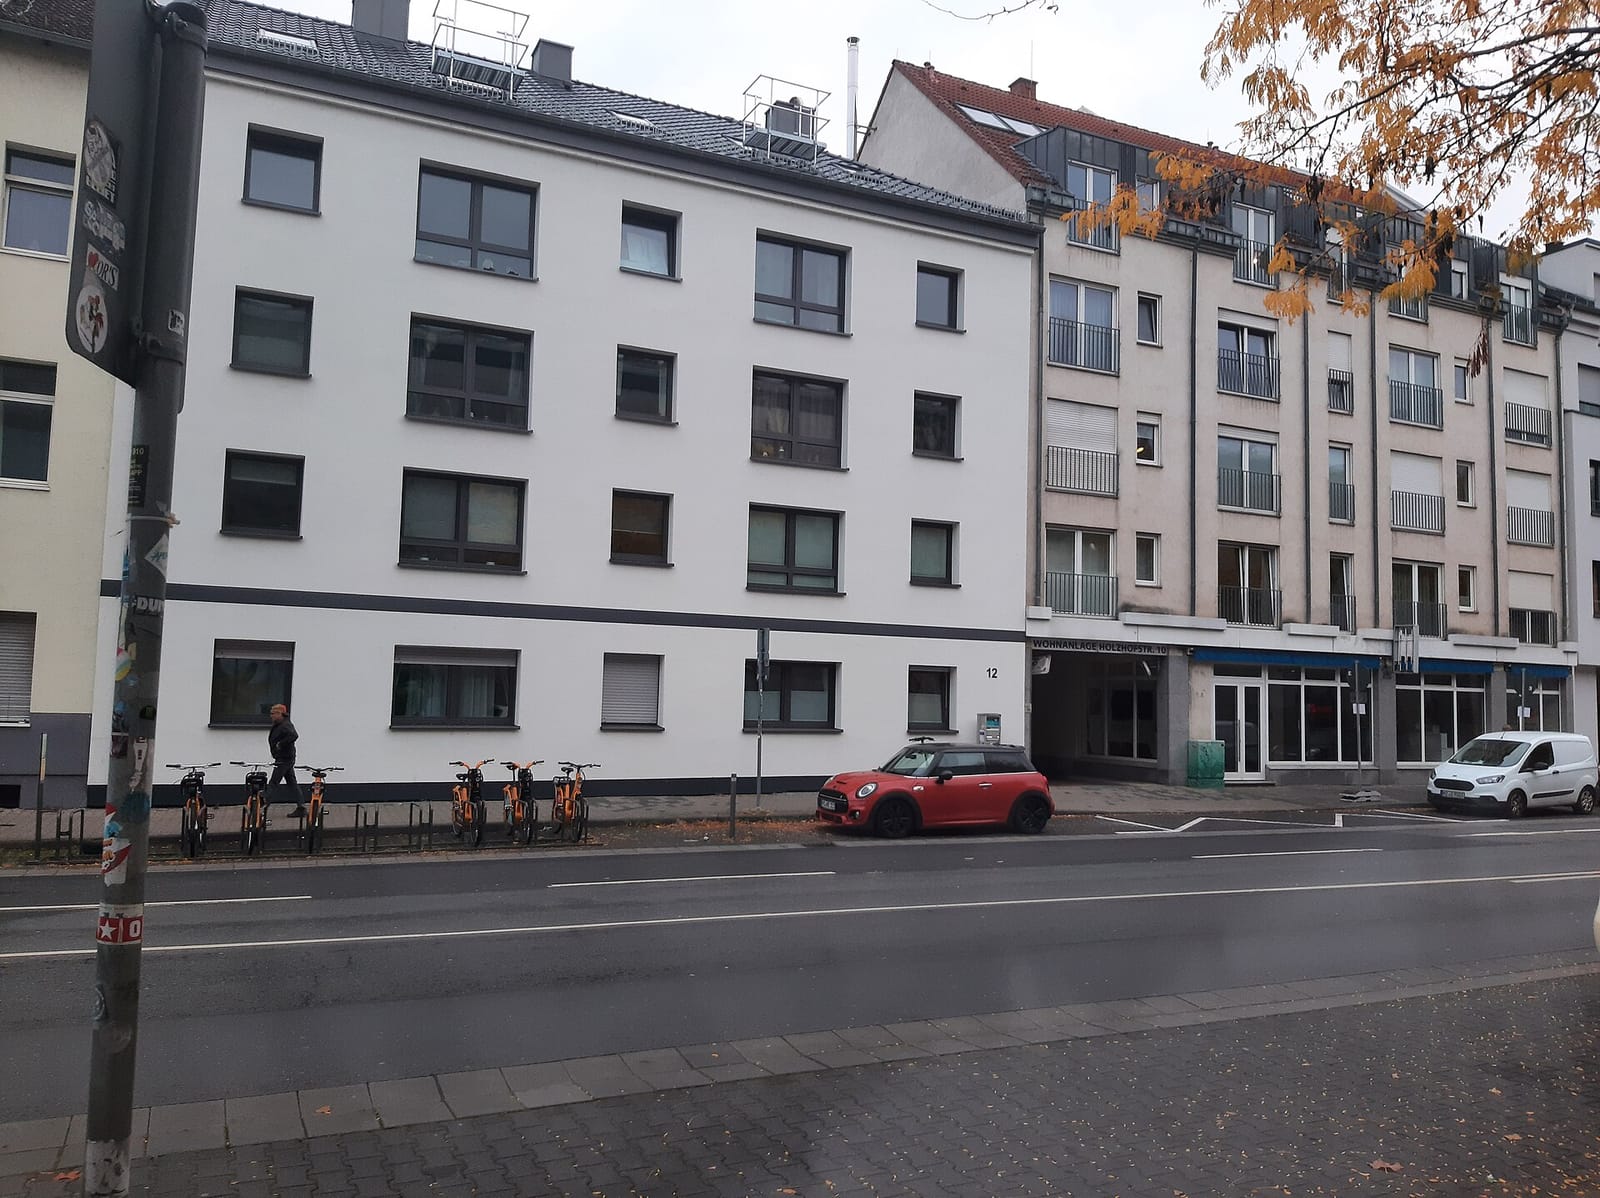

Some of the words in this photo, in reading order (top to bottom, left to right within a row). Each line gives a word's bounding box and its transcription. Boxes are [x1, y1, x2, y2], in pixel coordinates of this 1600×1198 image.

[1032, 639, 1097, 651] WOHNANLAGE
[1099, 642, 1155, 654] HOLZHOFSTR.
[1157, 645, 1167, 654] 10
[986, 667, 998, 679] 12
